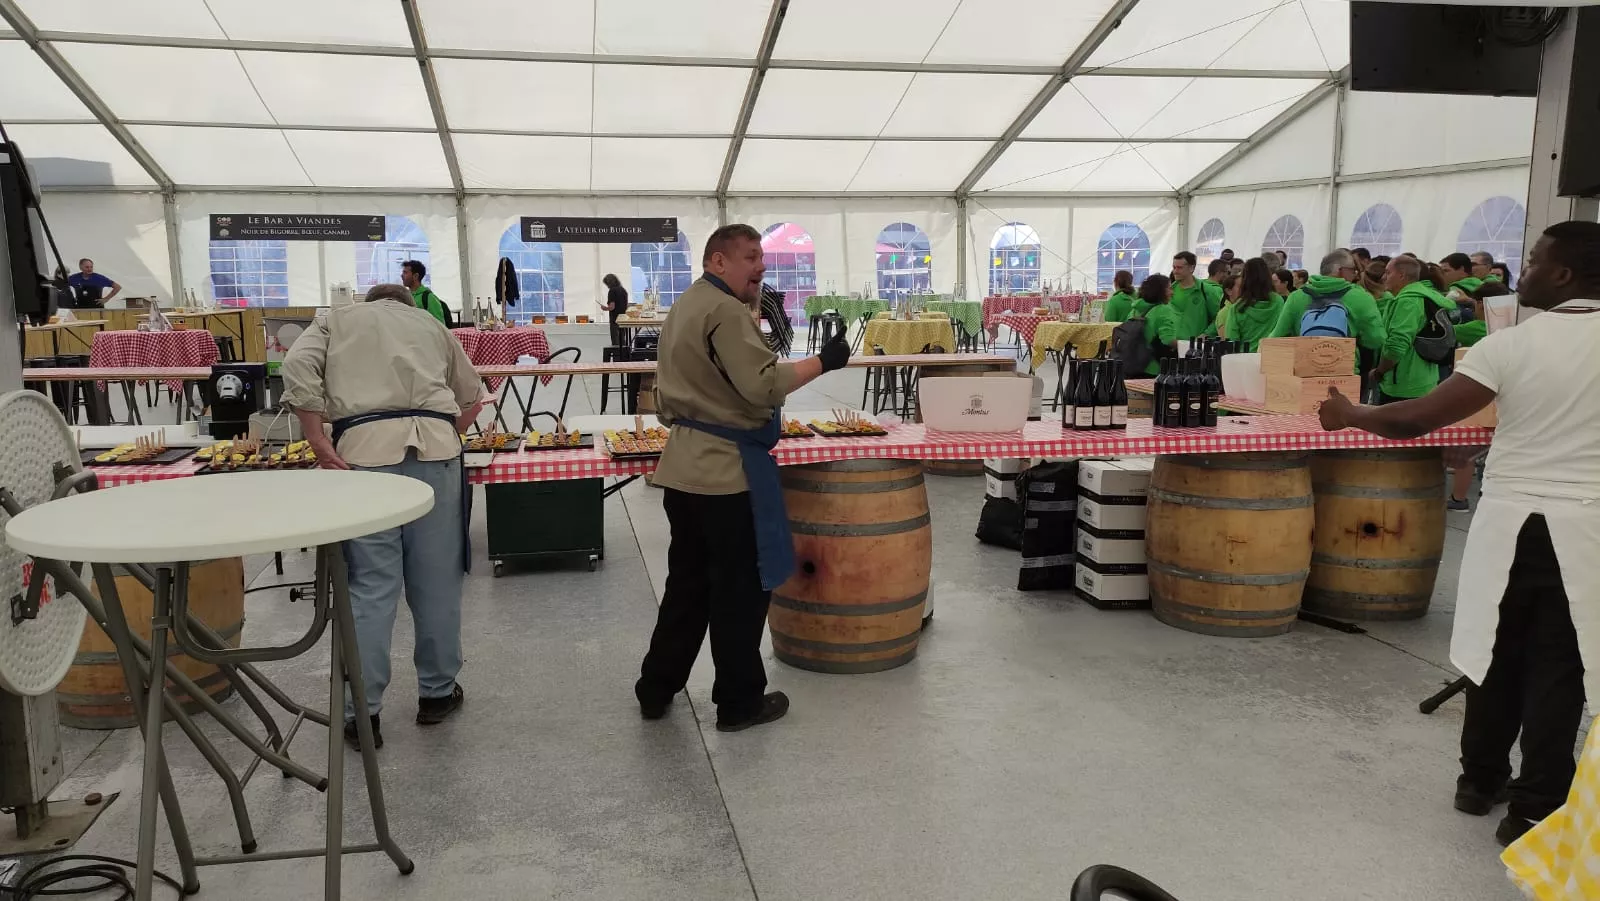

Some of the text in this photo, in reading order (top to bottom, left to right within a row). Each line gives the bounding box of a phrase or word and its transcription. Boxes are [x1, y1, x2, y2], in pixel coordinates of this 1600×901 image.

[248, 216, 261, 224] LE
[264, 216, 284, 225] BAR
[296, 216, 342, 225] VIANDES
[557, 226, 597, 234] L'ATELIER
[610, 226, 642, 234] BURGER
